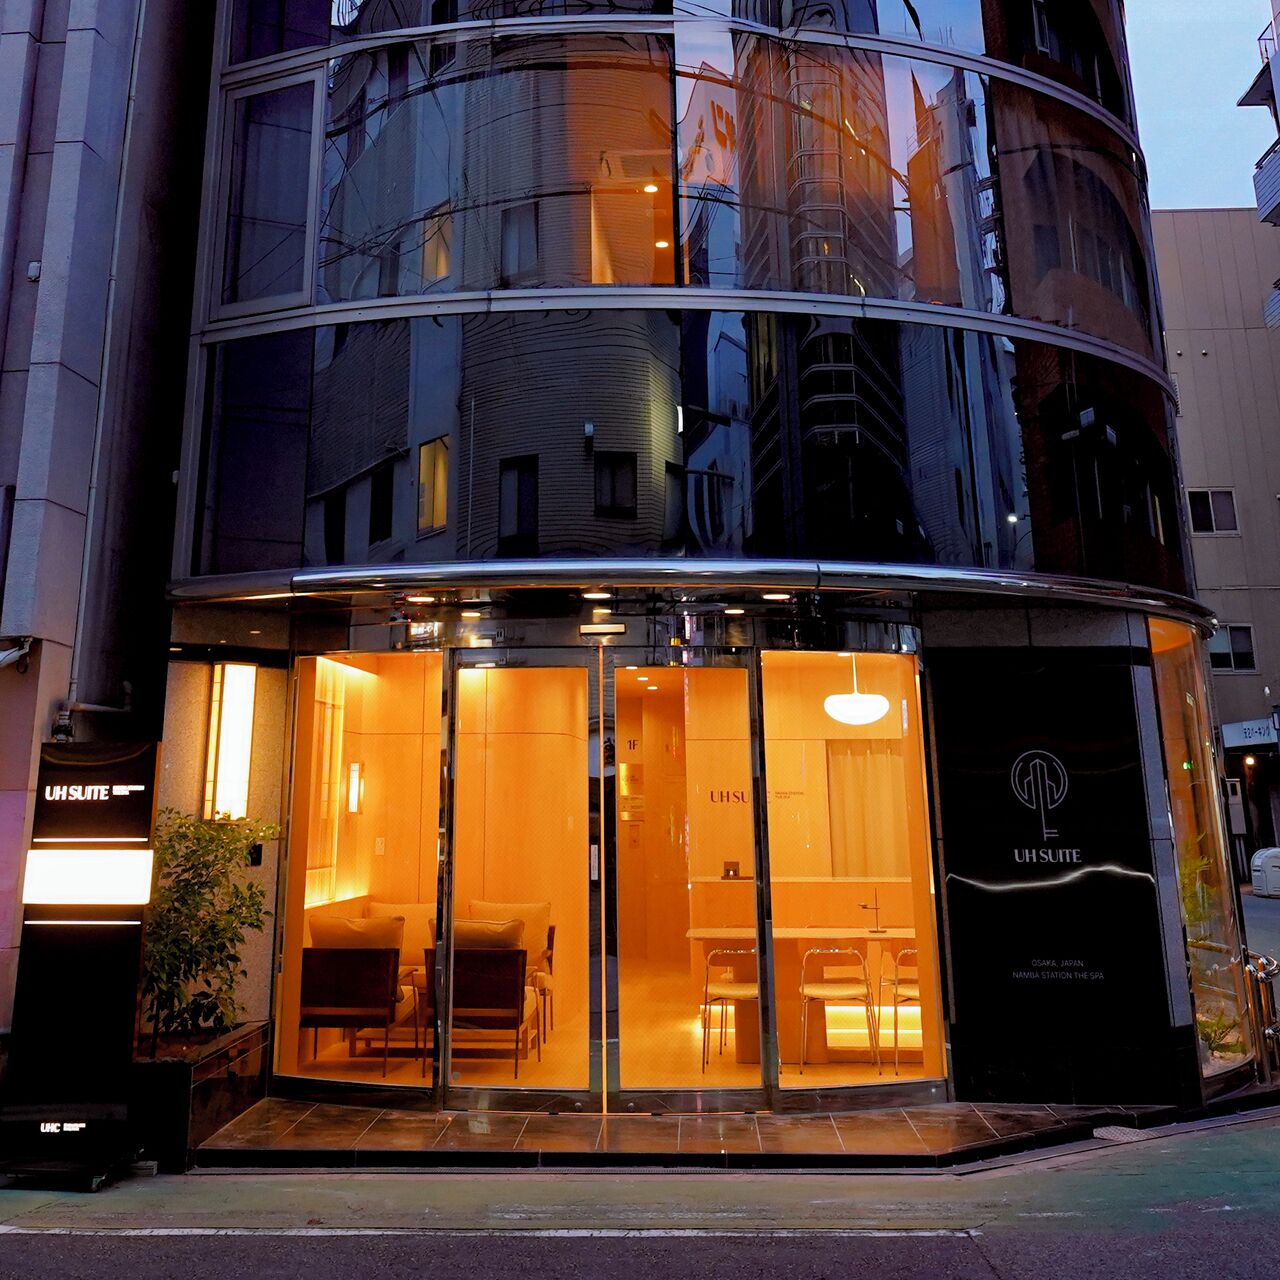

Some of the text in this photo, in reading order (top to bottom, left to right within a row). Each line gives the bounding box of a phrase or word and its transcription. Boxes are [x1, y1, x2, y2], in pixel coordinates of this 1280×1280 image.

[626, 739, 639, 751] 1F
[45, 785, 68, 801] UH
[68, 785, 110, 801] SUITE
[710, 790, 730, 803] UH
[1014, 848, 1082, 863] UH SUITE
[1060, 959, 1084, 967] JAPAN
[1041, 971, 1072, 979] STATION
[1073, 971, 1089, 979] THE
